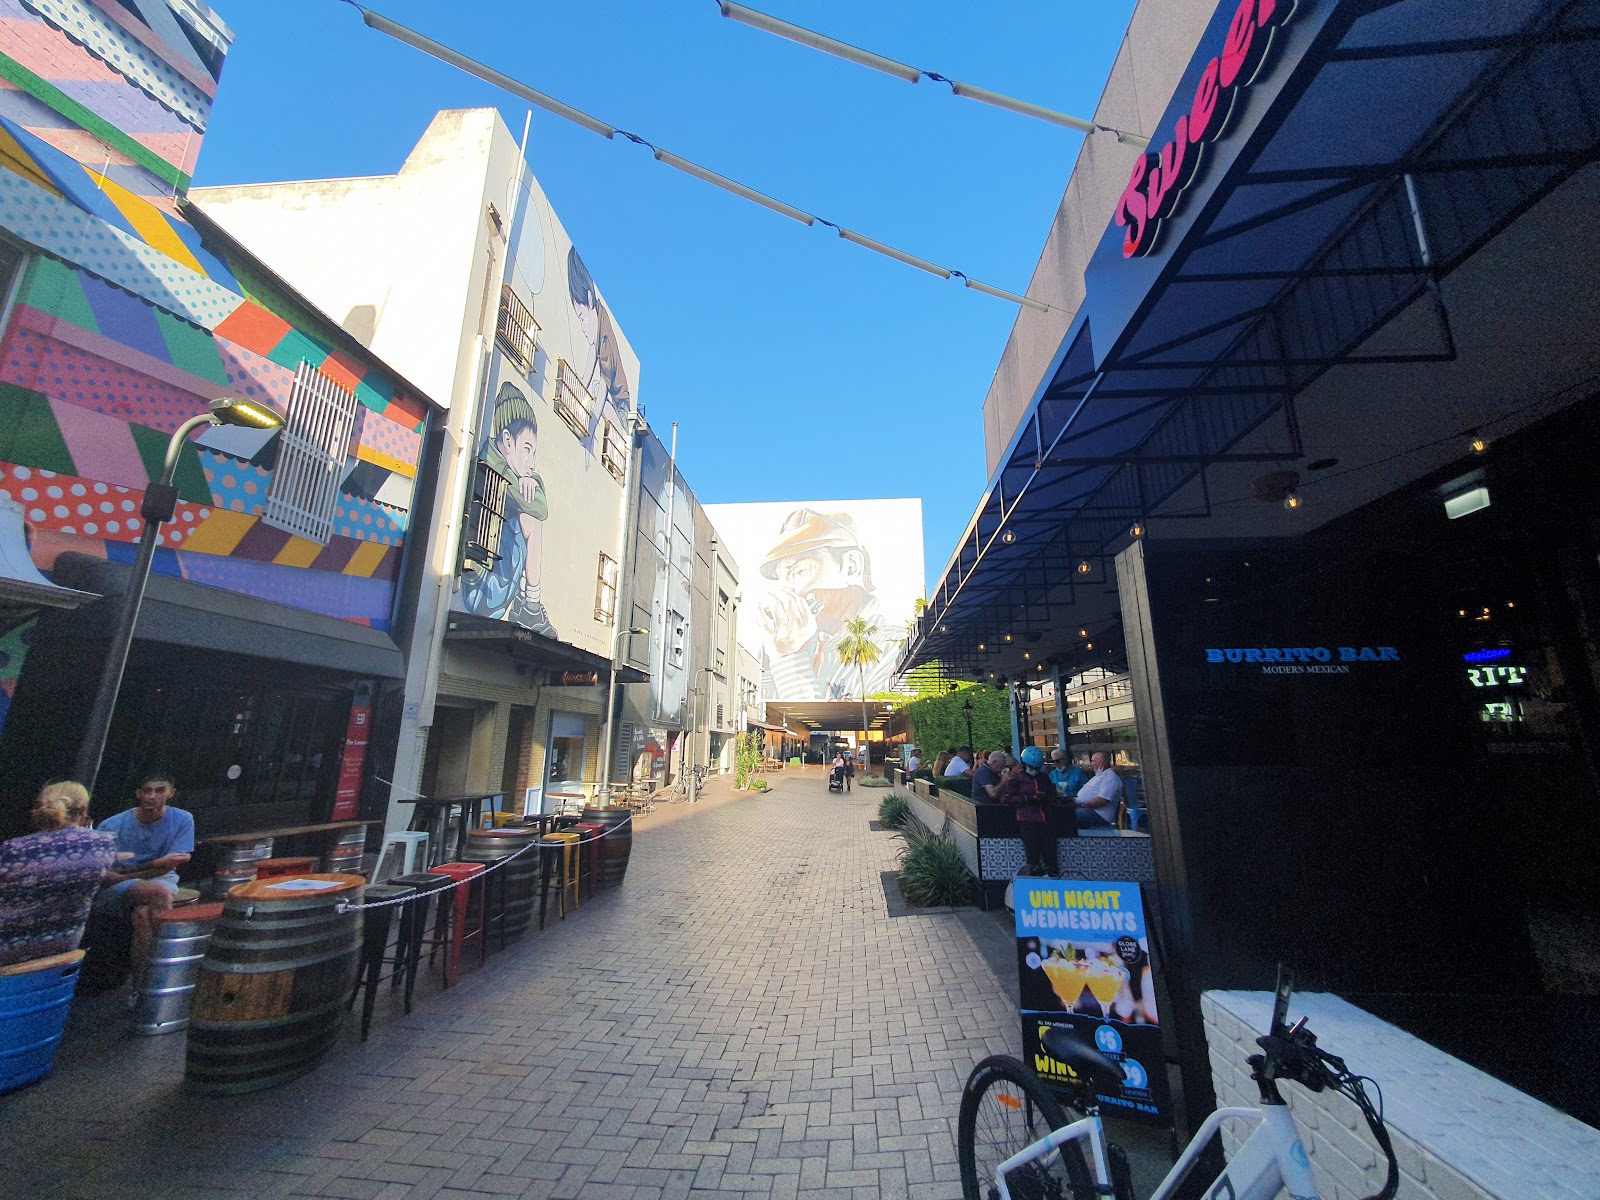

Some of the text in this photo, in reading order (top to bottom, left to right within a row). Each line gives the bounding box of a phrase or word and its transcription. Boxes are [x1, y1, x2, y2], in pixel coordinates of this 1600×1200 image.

[1206, 646, 1400, 663] BURRITO BAR
[1262, 665, 1350, 674] MODERN MEXICAN
[1029, 890, 1121, 910] UNI NIGHT
[1021, 909, 1138, 932] WEDNESDAYS
[1096, 1094, 1135, 1109] URRITO
